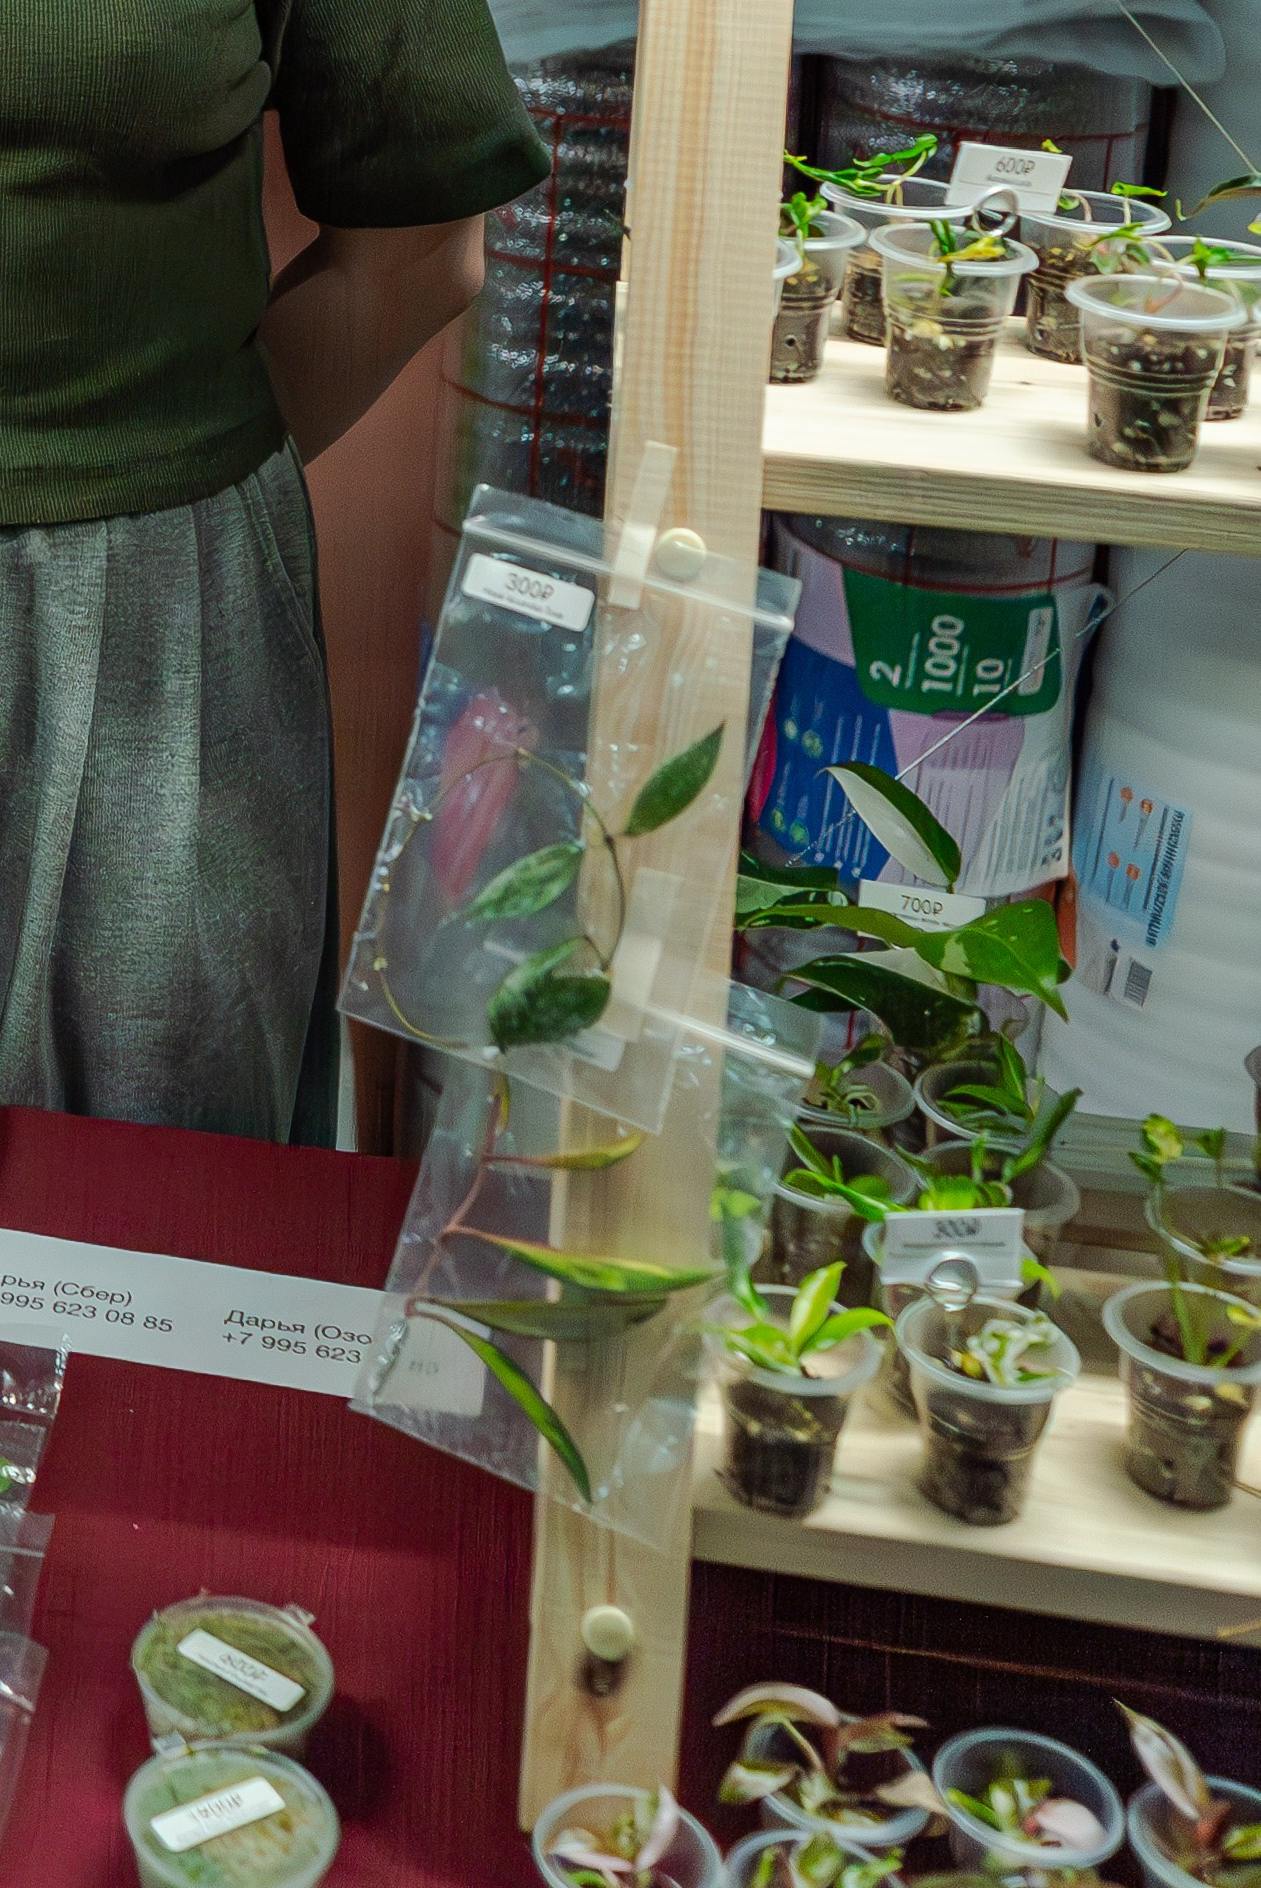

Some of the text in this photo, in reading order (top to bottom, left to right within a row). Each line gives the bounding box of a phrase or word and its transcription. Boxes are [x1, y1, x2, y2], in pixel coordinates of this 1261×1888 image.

[920, 614, 965, 693] 1000
[869, 660, 902, 689] 2
[972, 658, 1005, 697] 10
[900, 894, 944, 916] 700₽
[53, 1280, 132, 1307] (Сбер)
[0, 1292, 44, 1310] 995
[52, 1301, 97, 1319] 623
[105, 1310, 135, 1326] 08
[143, 1316, 174, 1333] 85
[223, 1309, 306, 1334] Дарья
[222, 1331, 361, 1364] +7 995 623
